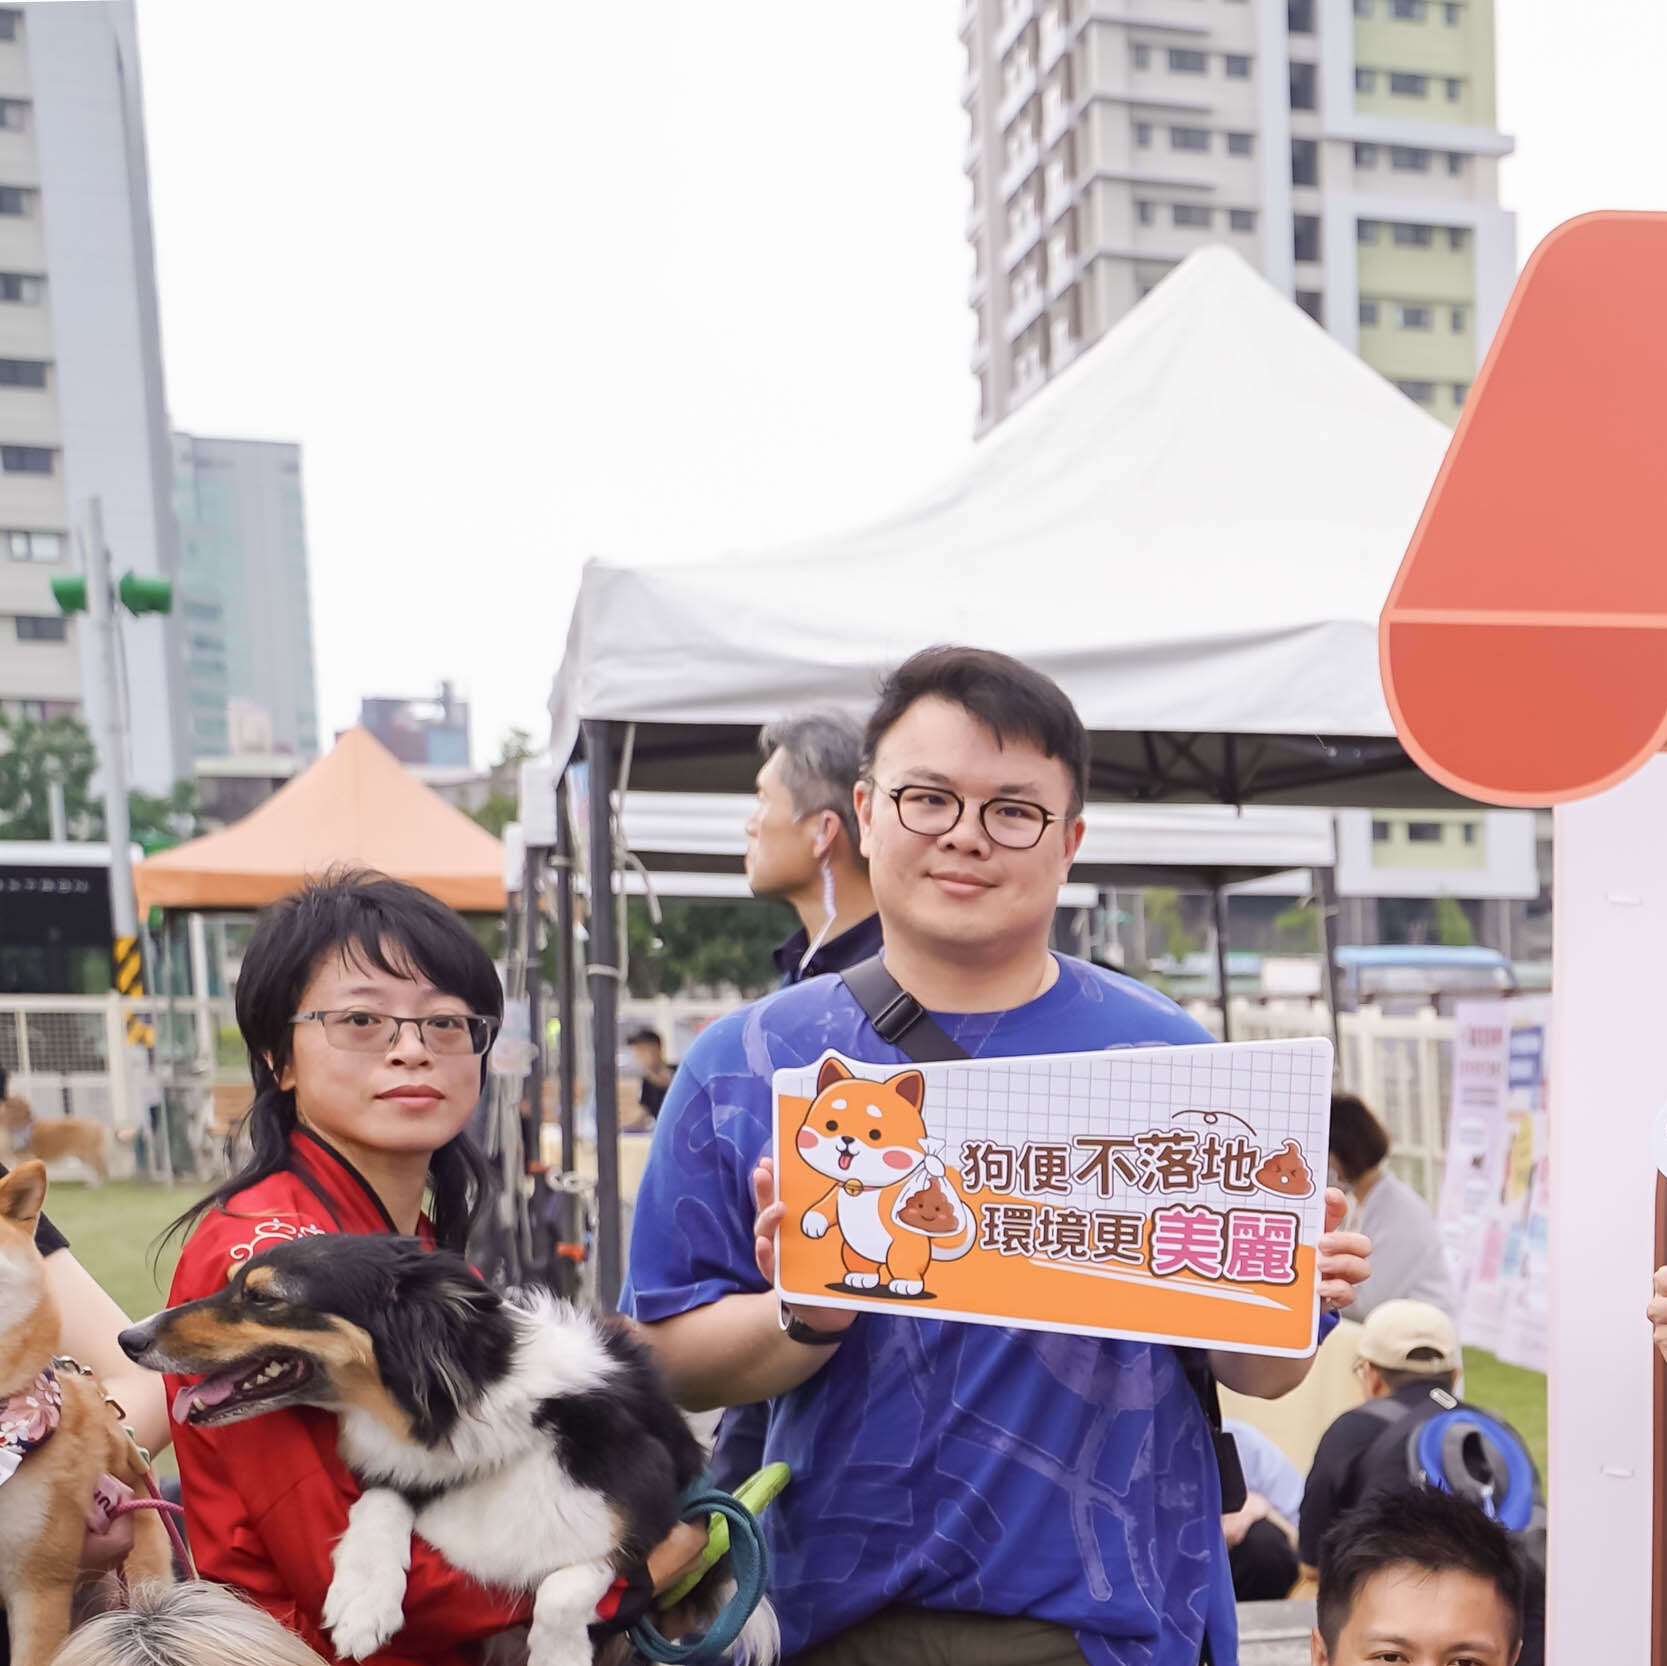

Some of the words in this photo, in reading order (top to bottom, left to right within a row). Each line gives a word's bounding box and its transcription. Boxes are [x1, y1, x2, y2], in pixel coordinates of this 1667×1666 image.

[963, 1131, 1258, 1197] 狗便不落地
[981, 1208, 1297, 1283] 環境更美麗
